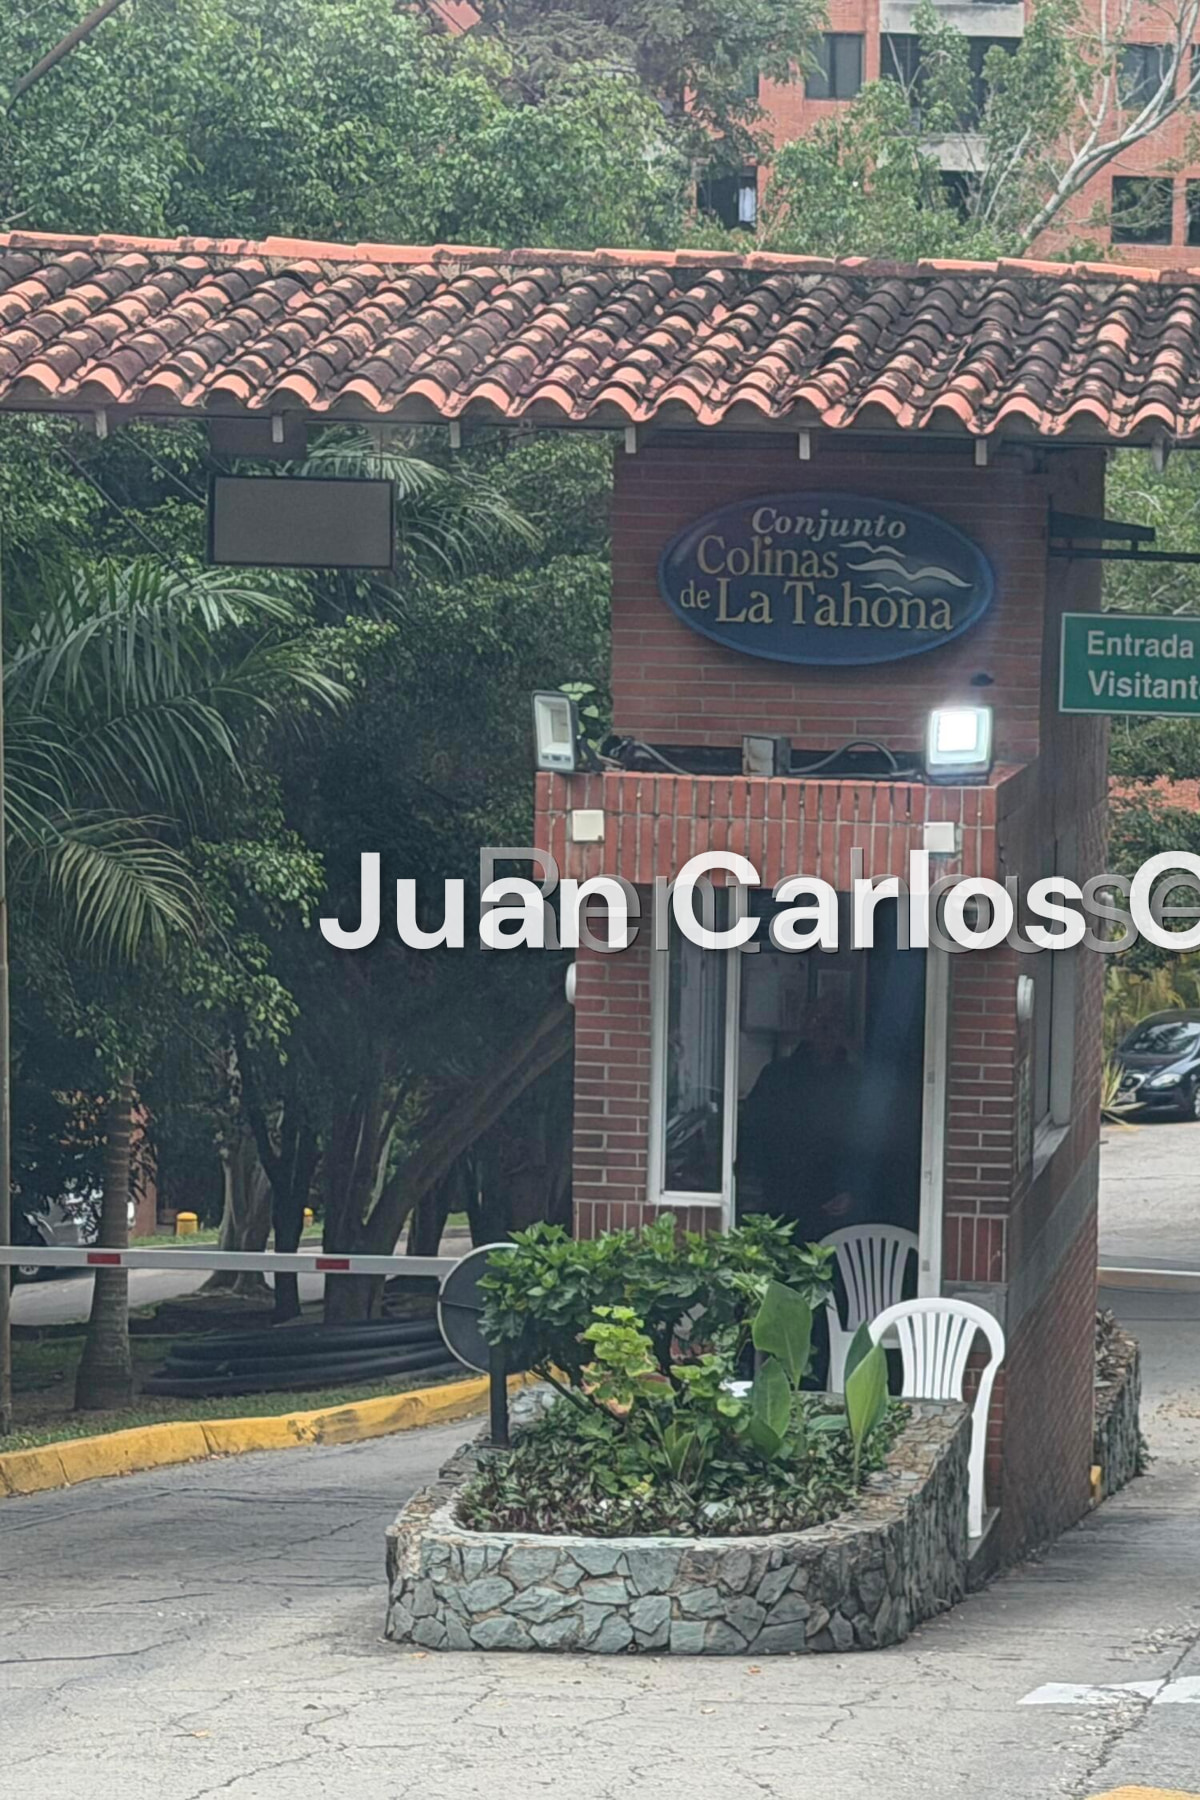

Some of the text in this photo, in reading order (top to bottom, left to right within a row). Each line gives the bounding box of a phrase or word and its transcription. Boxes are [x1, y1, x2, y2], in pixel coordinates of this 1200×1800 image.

[752, 507, 906, 541] Conjunto
[698, 535, 839, 579] Colinas
[680, 578, 954, 631] de La Tahona
[1087, 630, 1194, 659] Entrada
